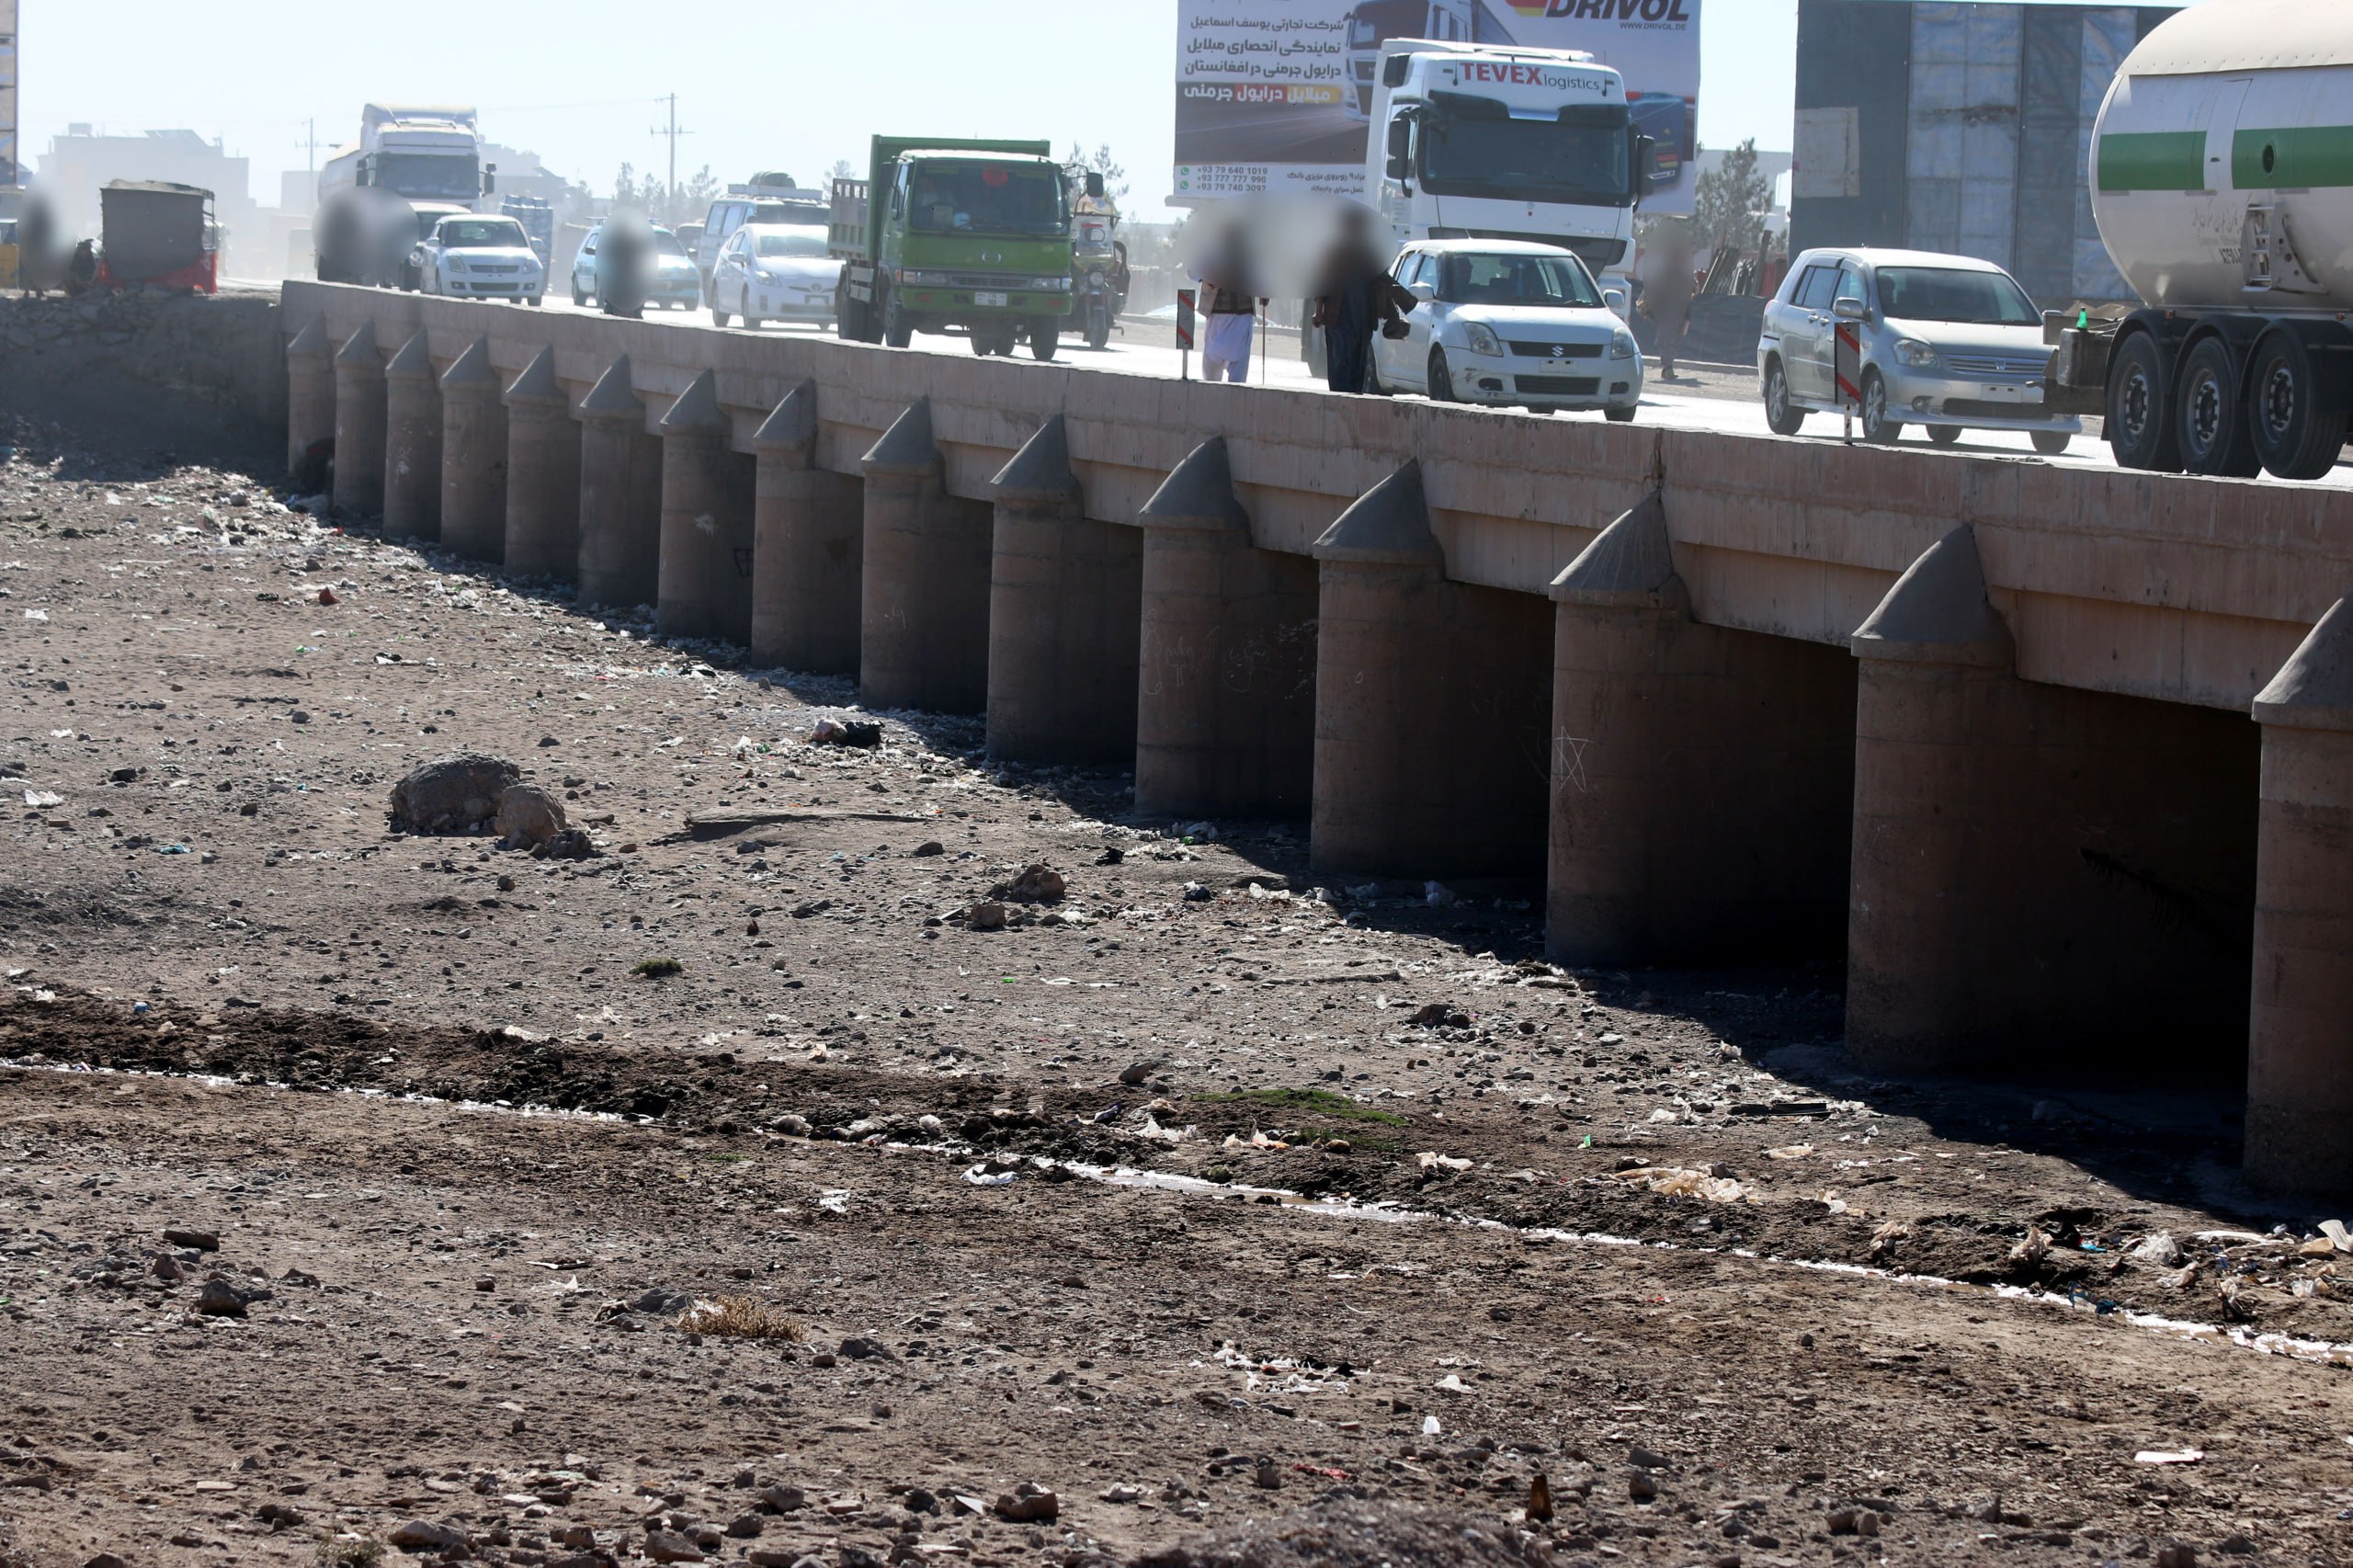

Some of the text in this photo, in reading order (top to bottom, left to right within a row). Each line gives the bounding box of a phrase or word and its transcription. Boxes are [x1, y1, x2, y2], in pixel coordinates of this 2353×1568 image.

[1546, 0, 1689, 21] DRIVOL
[1190, 16, 1344, 32] شرکت تجارتی یوسف اسماعیل
[1620, 22, 1687, 30] WWW.DRIVOL.DE
[1187, 38, 1341, 56] نمایندگی انحصاری مبلایل
[1185, 60, 1341, 79] درایول جرمنی در افغانستان
[1460, 62, 1600, 90] TEVEX logistics
[1184, 83, 1331, 104] مبلایل درایول جرمنی
